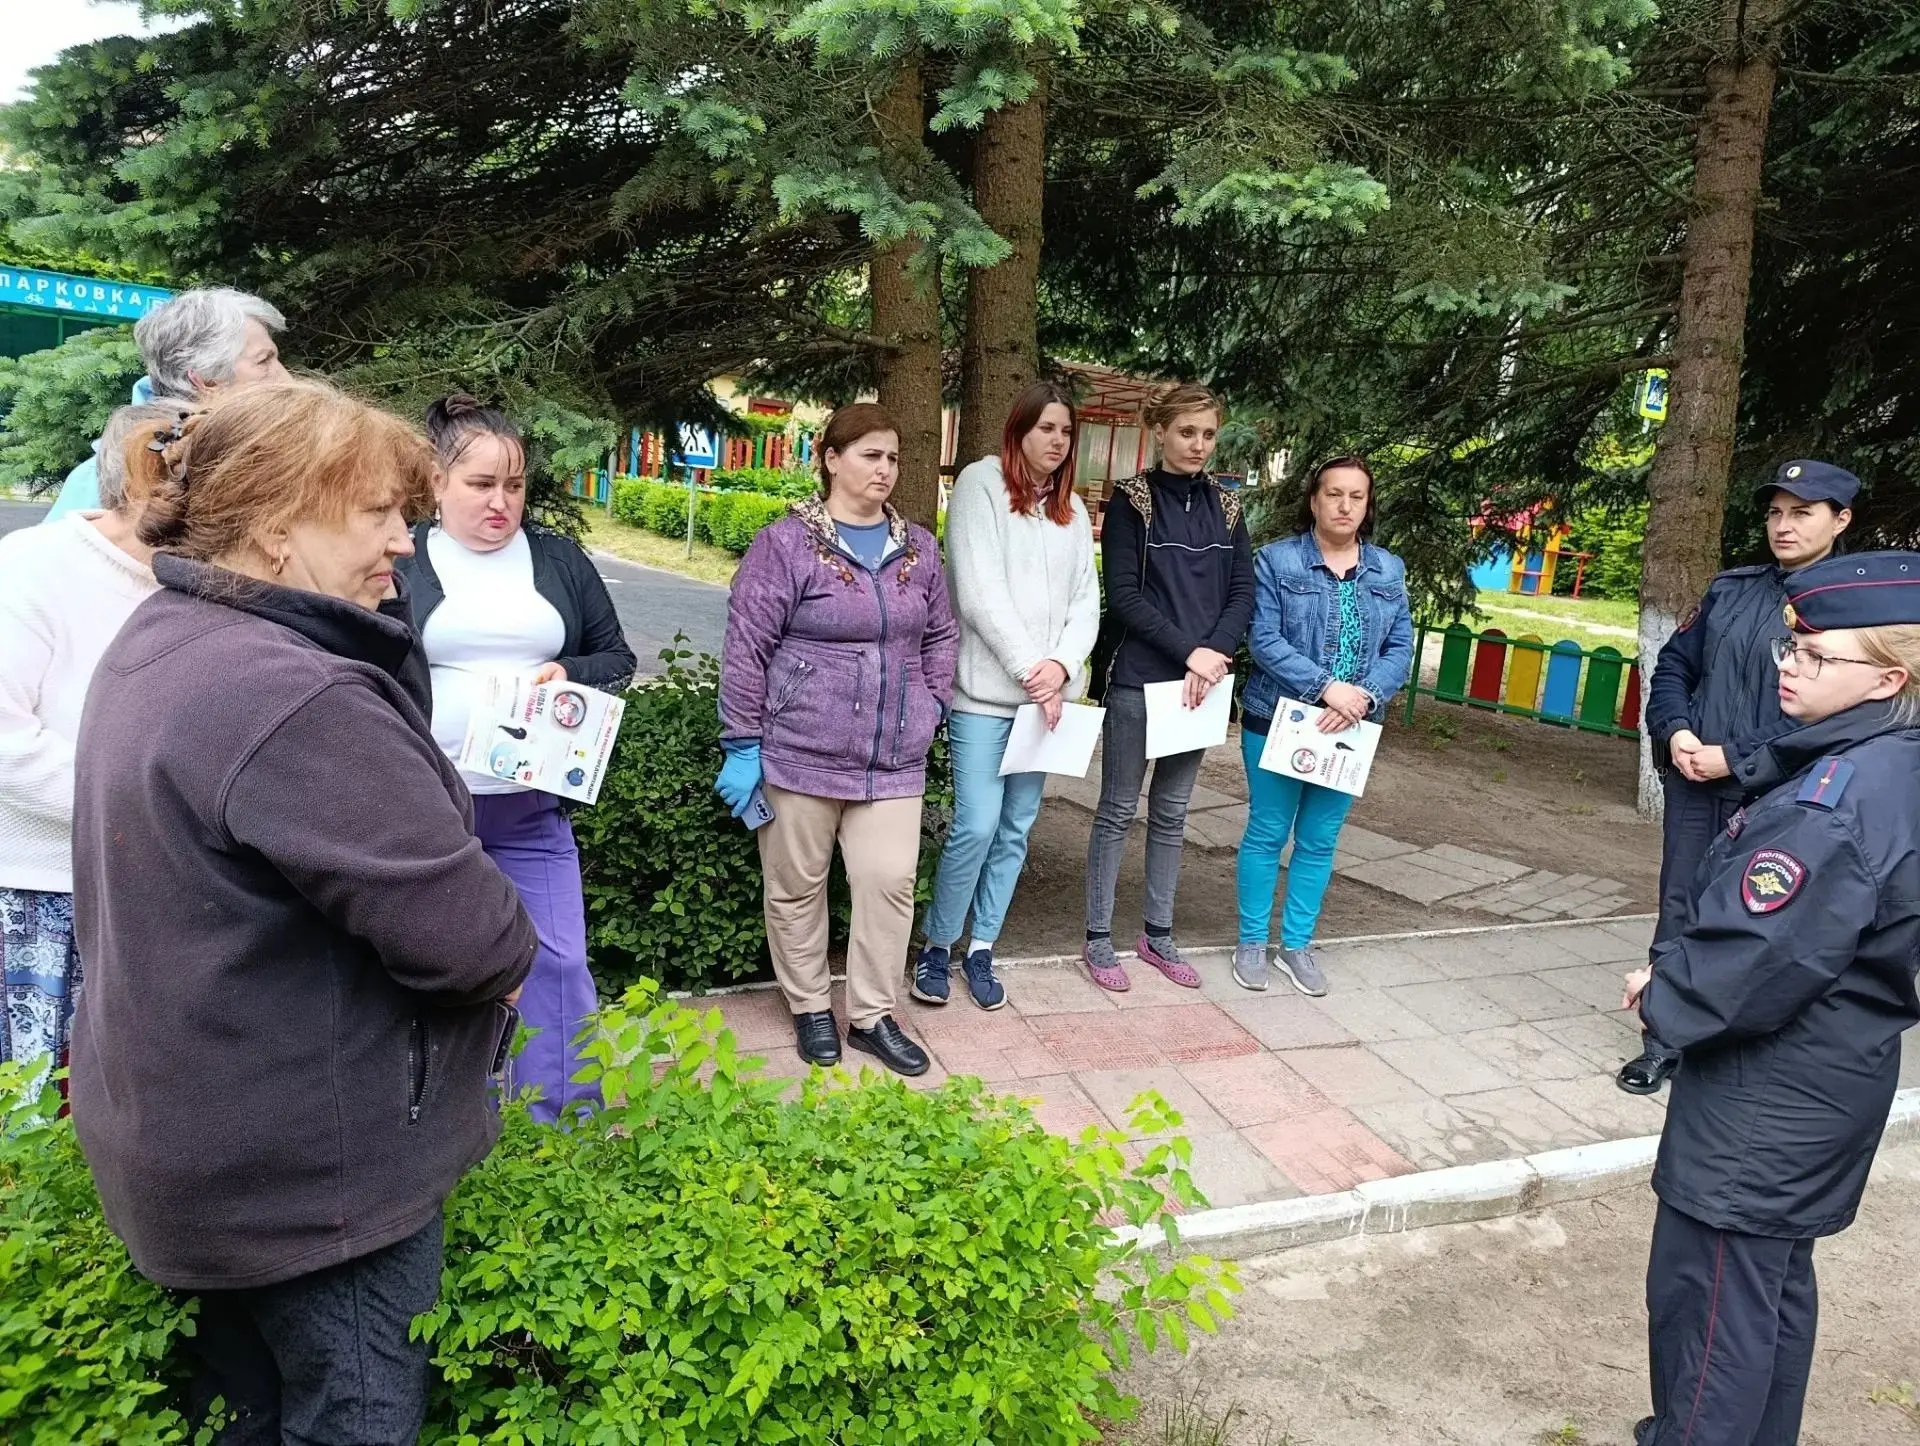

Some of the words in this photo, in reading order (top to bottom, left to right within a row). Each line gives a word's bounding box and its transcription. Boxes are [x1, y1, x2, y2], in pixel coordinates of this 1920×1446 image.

[0, 273, 142, 306] ПАРКОВКА
[535, 687, 547, 716] БУДЬТЕ
[1754, 861, 1794, 884] РОССИЯ
[1757, 852, 1801, 877] ПОЛИЦИЯ
[1748, 896, 1767, 913] МВД
